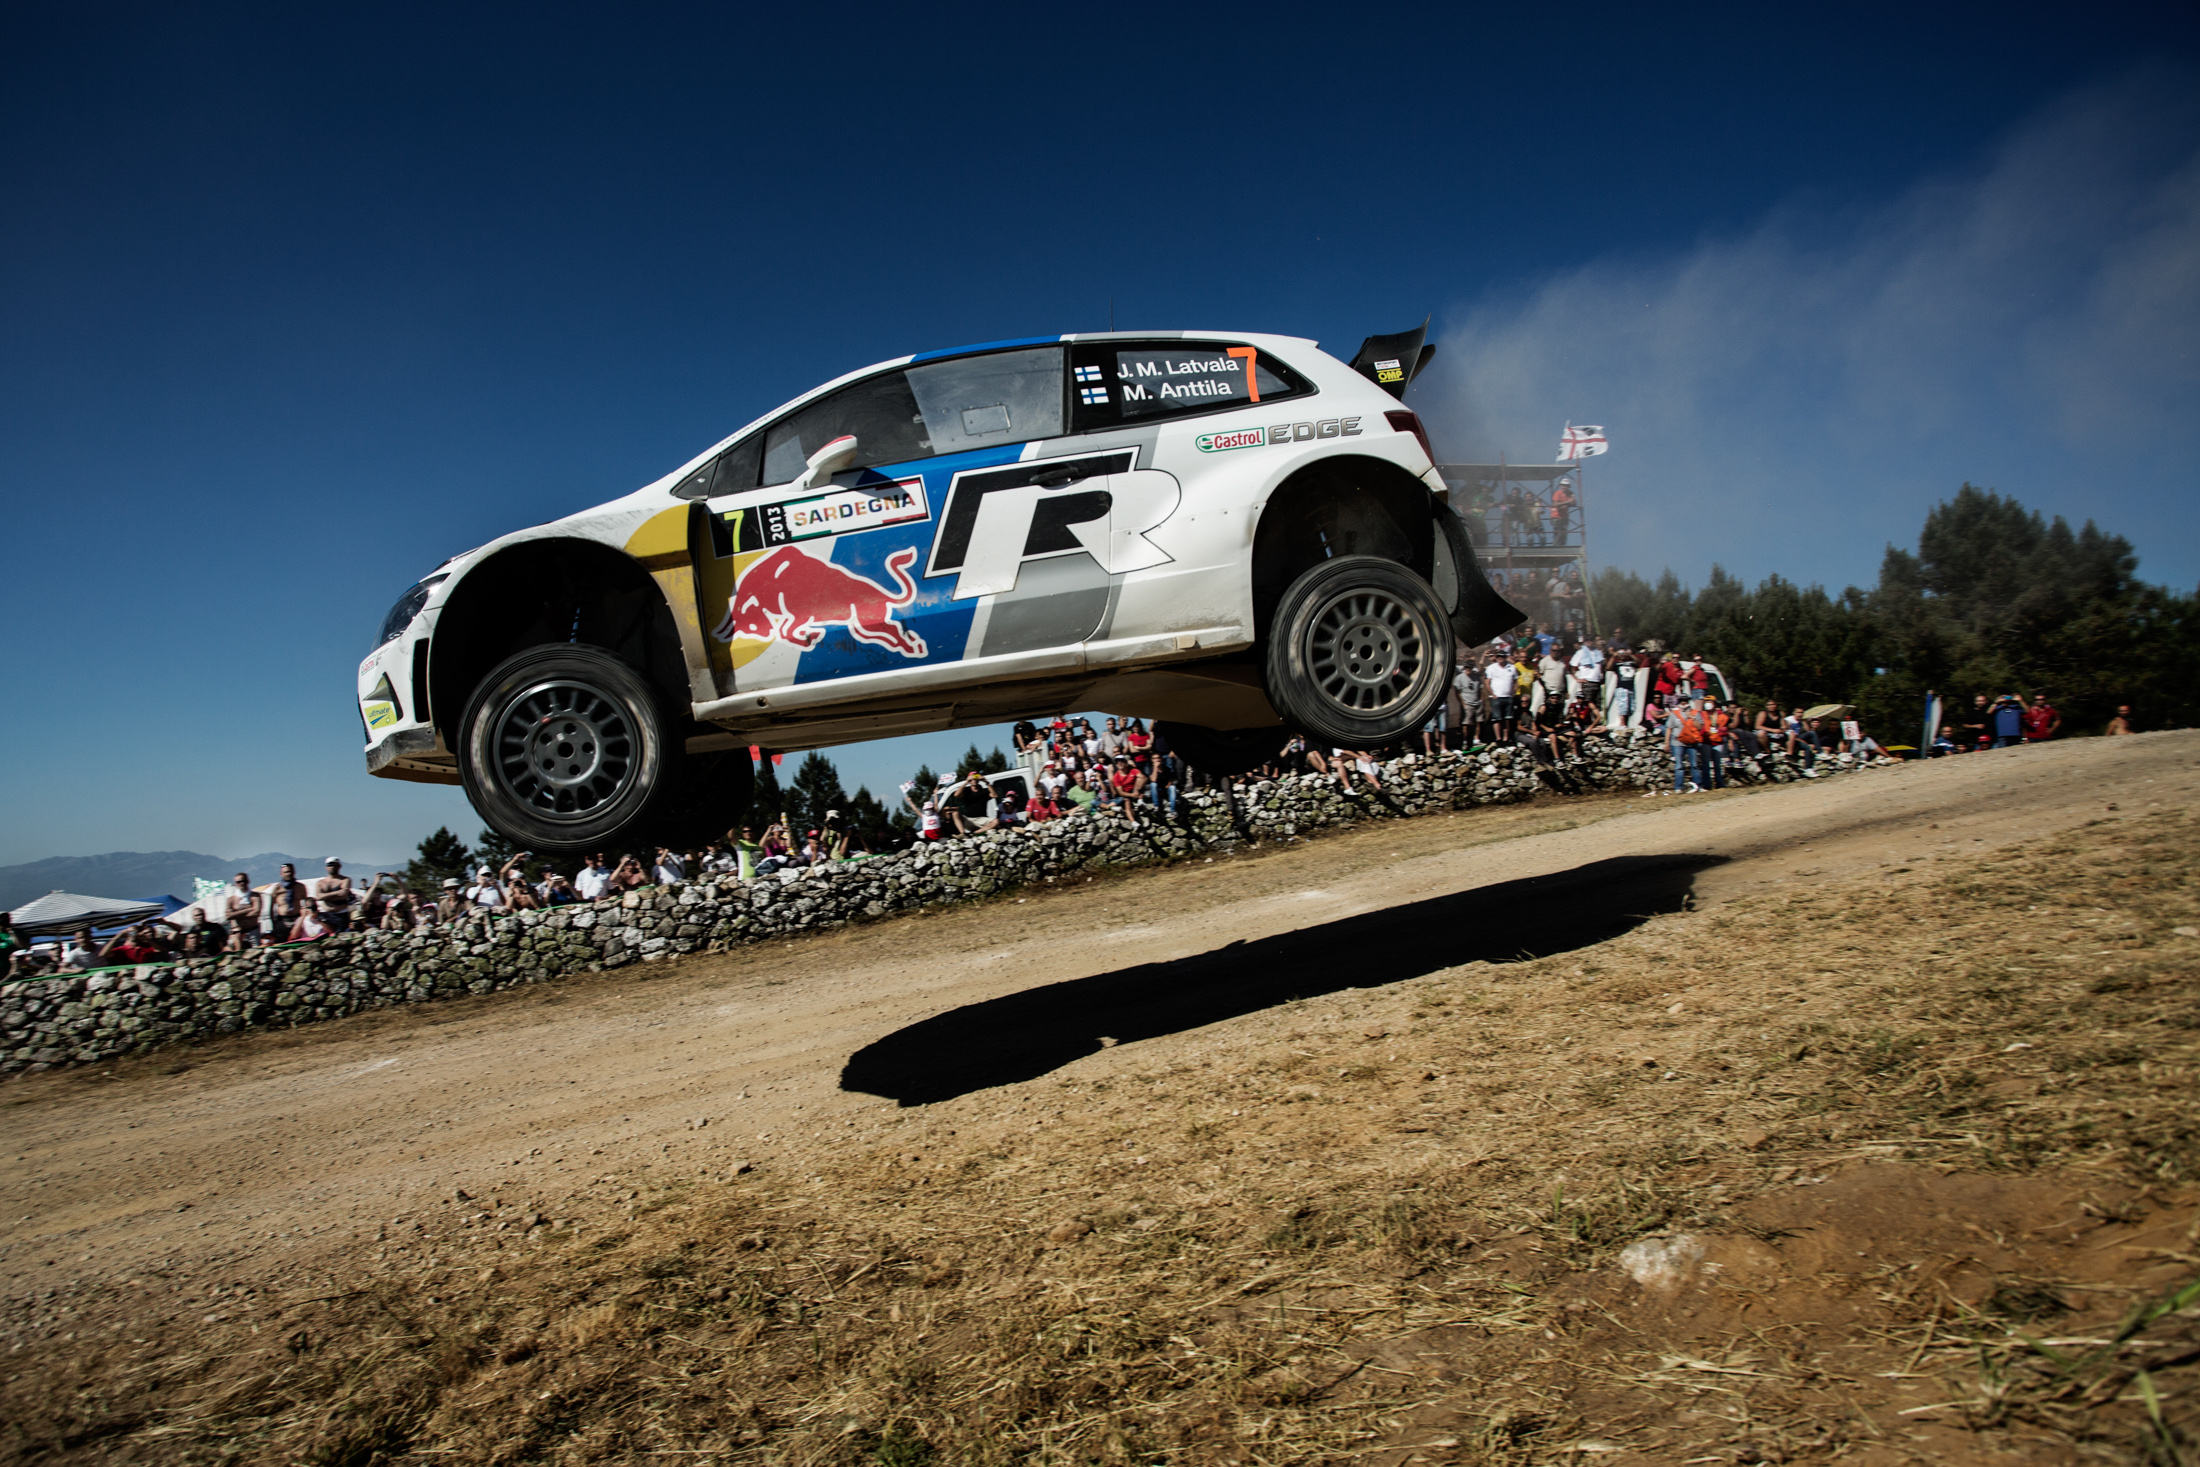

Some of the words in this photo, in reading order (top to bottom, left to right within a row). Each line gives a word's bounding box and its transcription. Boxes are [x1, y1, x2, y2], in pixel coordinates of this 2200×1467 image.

[1117, 363, 1134, 378] J.
[1136, 361, 1162, 377] M.
[1165, 357, 1240, 375] Latvala
[1226, 346, 1260, 402] 7
[1378, 370, 1403, 380] OMP
[1123, 384, 1153, 401] M.
[1160, 380, 1232, 399] Anttila
[1214, 431, 1261, 449] Castrol
[1268, 416, 1363, 445] EDGE
[767, 506, 785, 541] 2013
[794, 493, 916, 526] SARDEGNA
[923, 445, 1181, 602] R
[724, 510, 745, 553] 7
